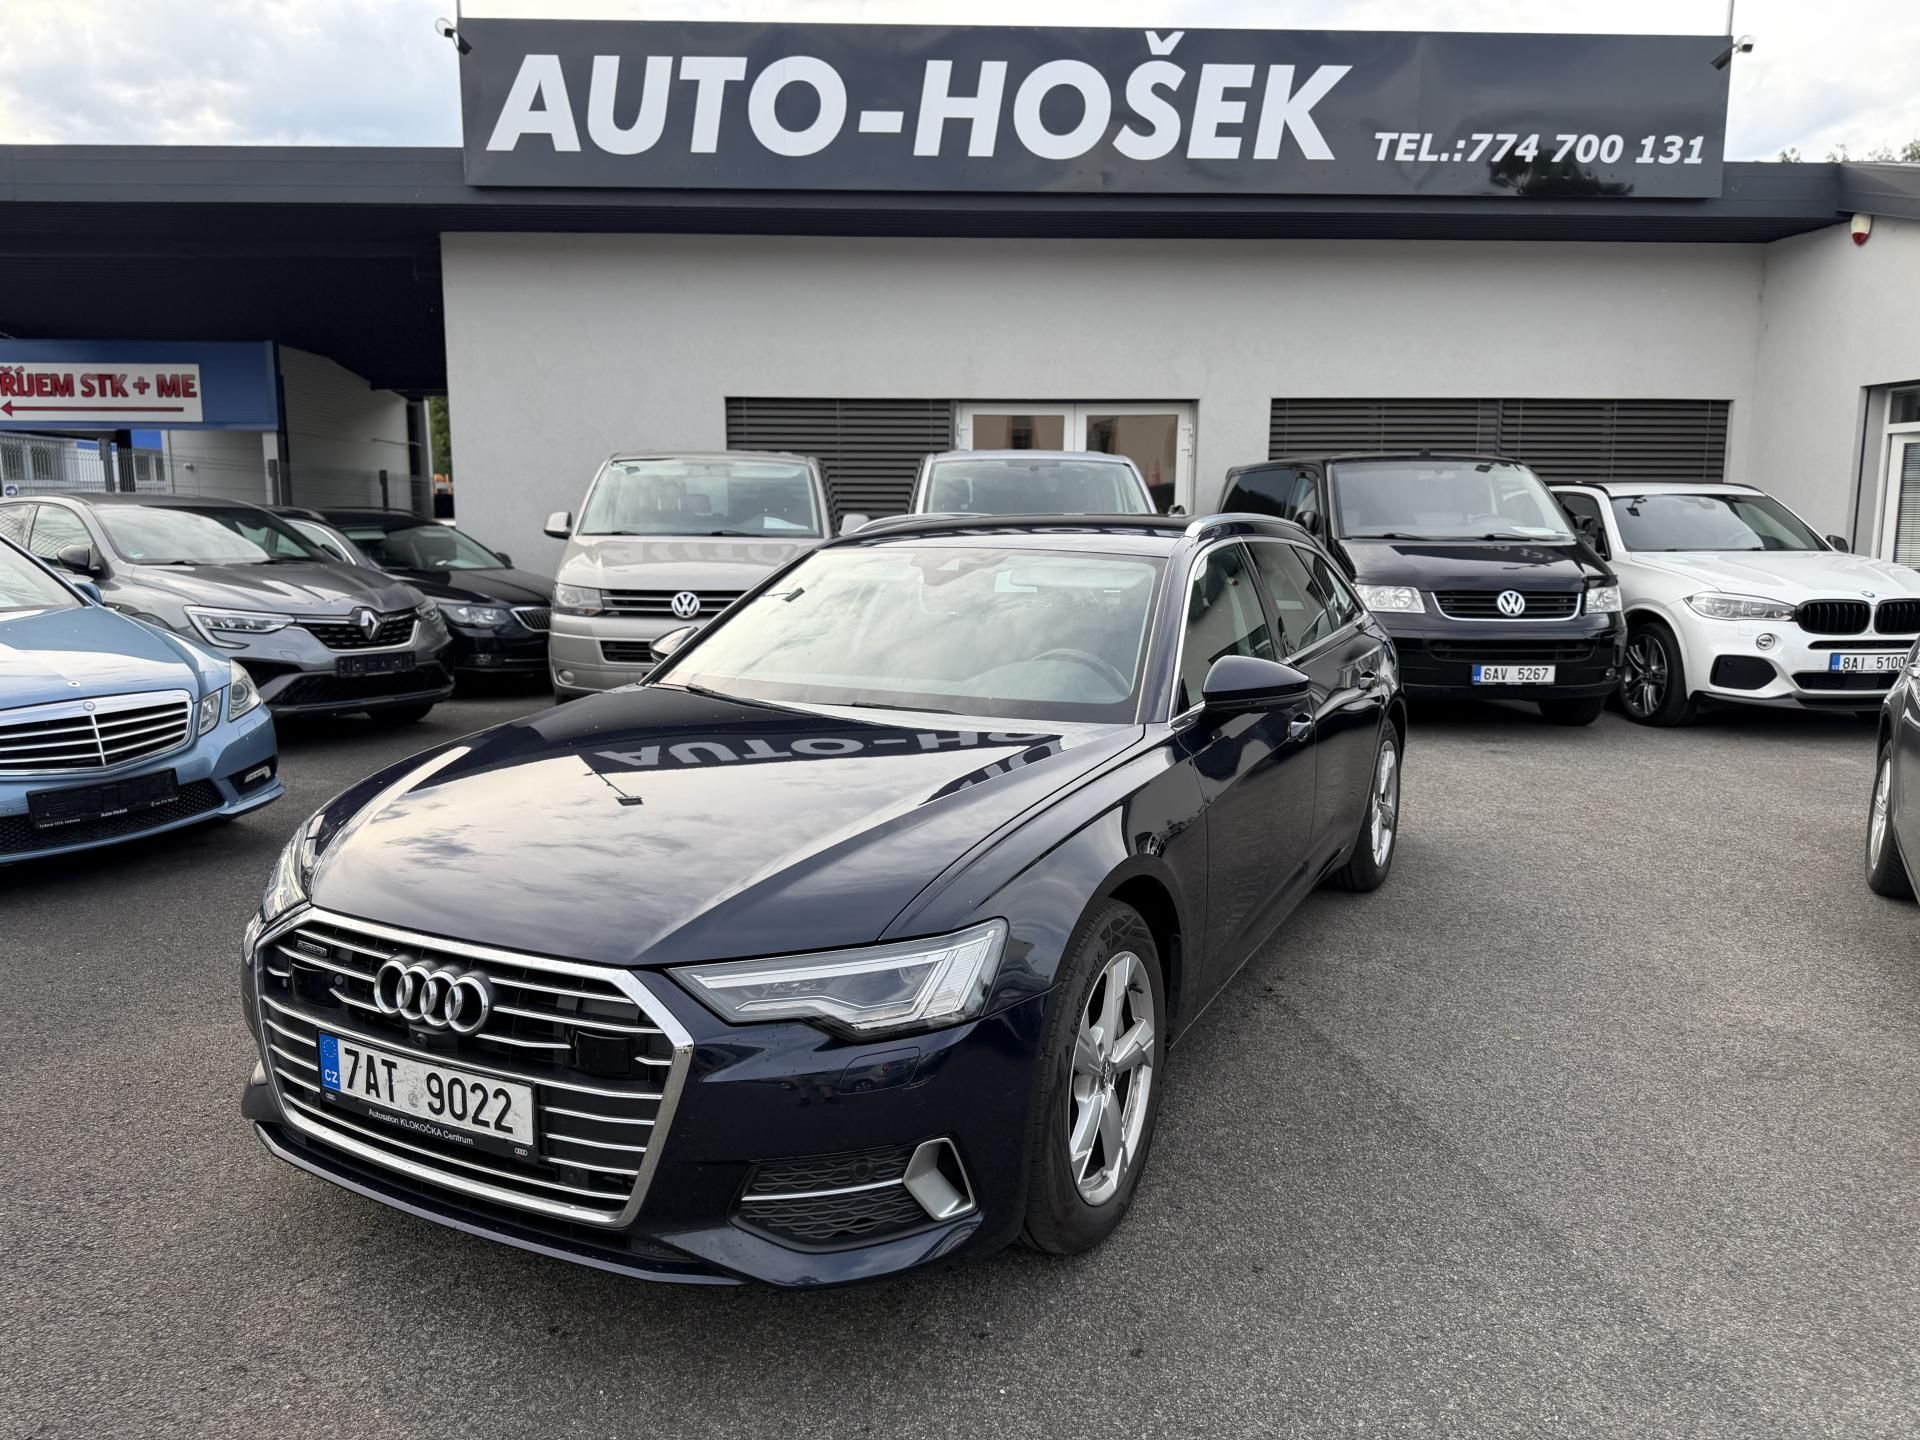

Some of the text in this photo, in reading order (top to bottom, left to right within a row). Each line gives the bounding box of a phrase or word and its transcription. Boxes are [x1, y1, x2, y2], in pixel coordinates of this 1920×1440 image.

[485, 31, 1353, 160] AUTO-HOŠEK
[1550, 134, 1624, 163] 700
[1635, 135, 1705, 164] 131
[80, 374, 129, 397] STK
[133, 376, 150, 395] +
[156, 374, 197, 398] ME
[1483, 667, 1508, 681] 6AV
[1517, 667, 1549, 681] 5267
[1876, 656, 1907, 670] 5100
[324, 1069, 338, 1084] CZ
[344, 1047, 514, 1135] 7AT 9022
[368, 1107, 474, 1146] Autosalon KLOKOČKA Centrum
